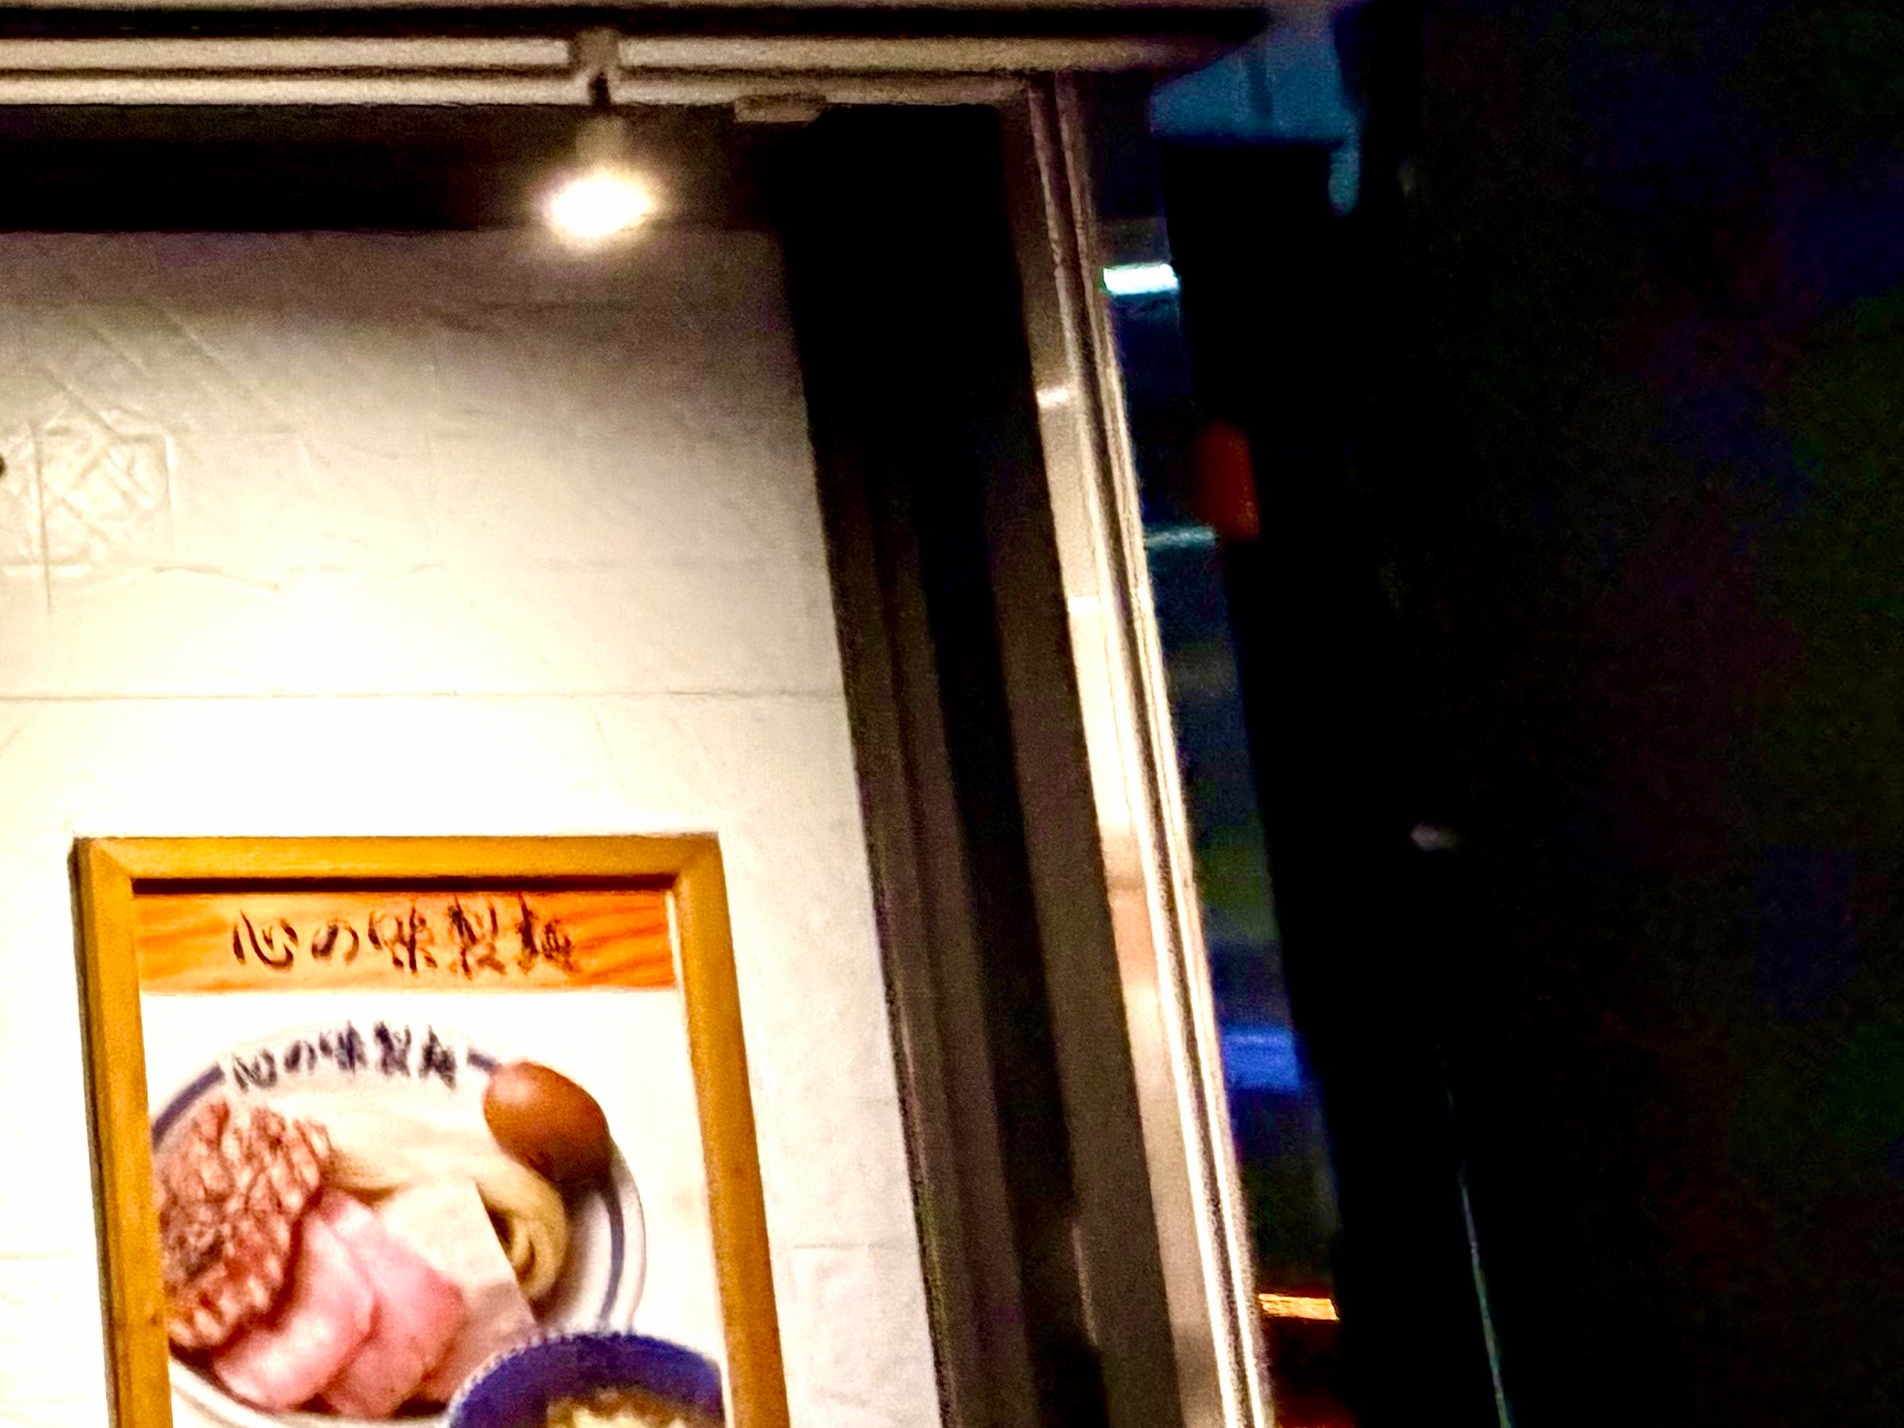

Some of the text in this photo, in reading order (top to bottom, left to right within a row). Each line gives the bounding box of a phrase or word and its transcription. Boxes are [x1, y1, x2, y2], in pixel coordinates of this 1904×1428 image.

[230, 893, 578, 978] 心の味製麺
